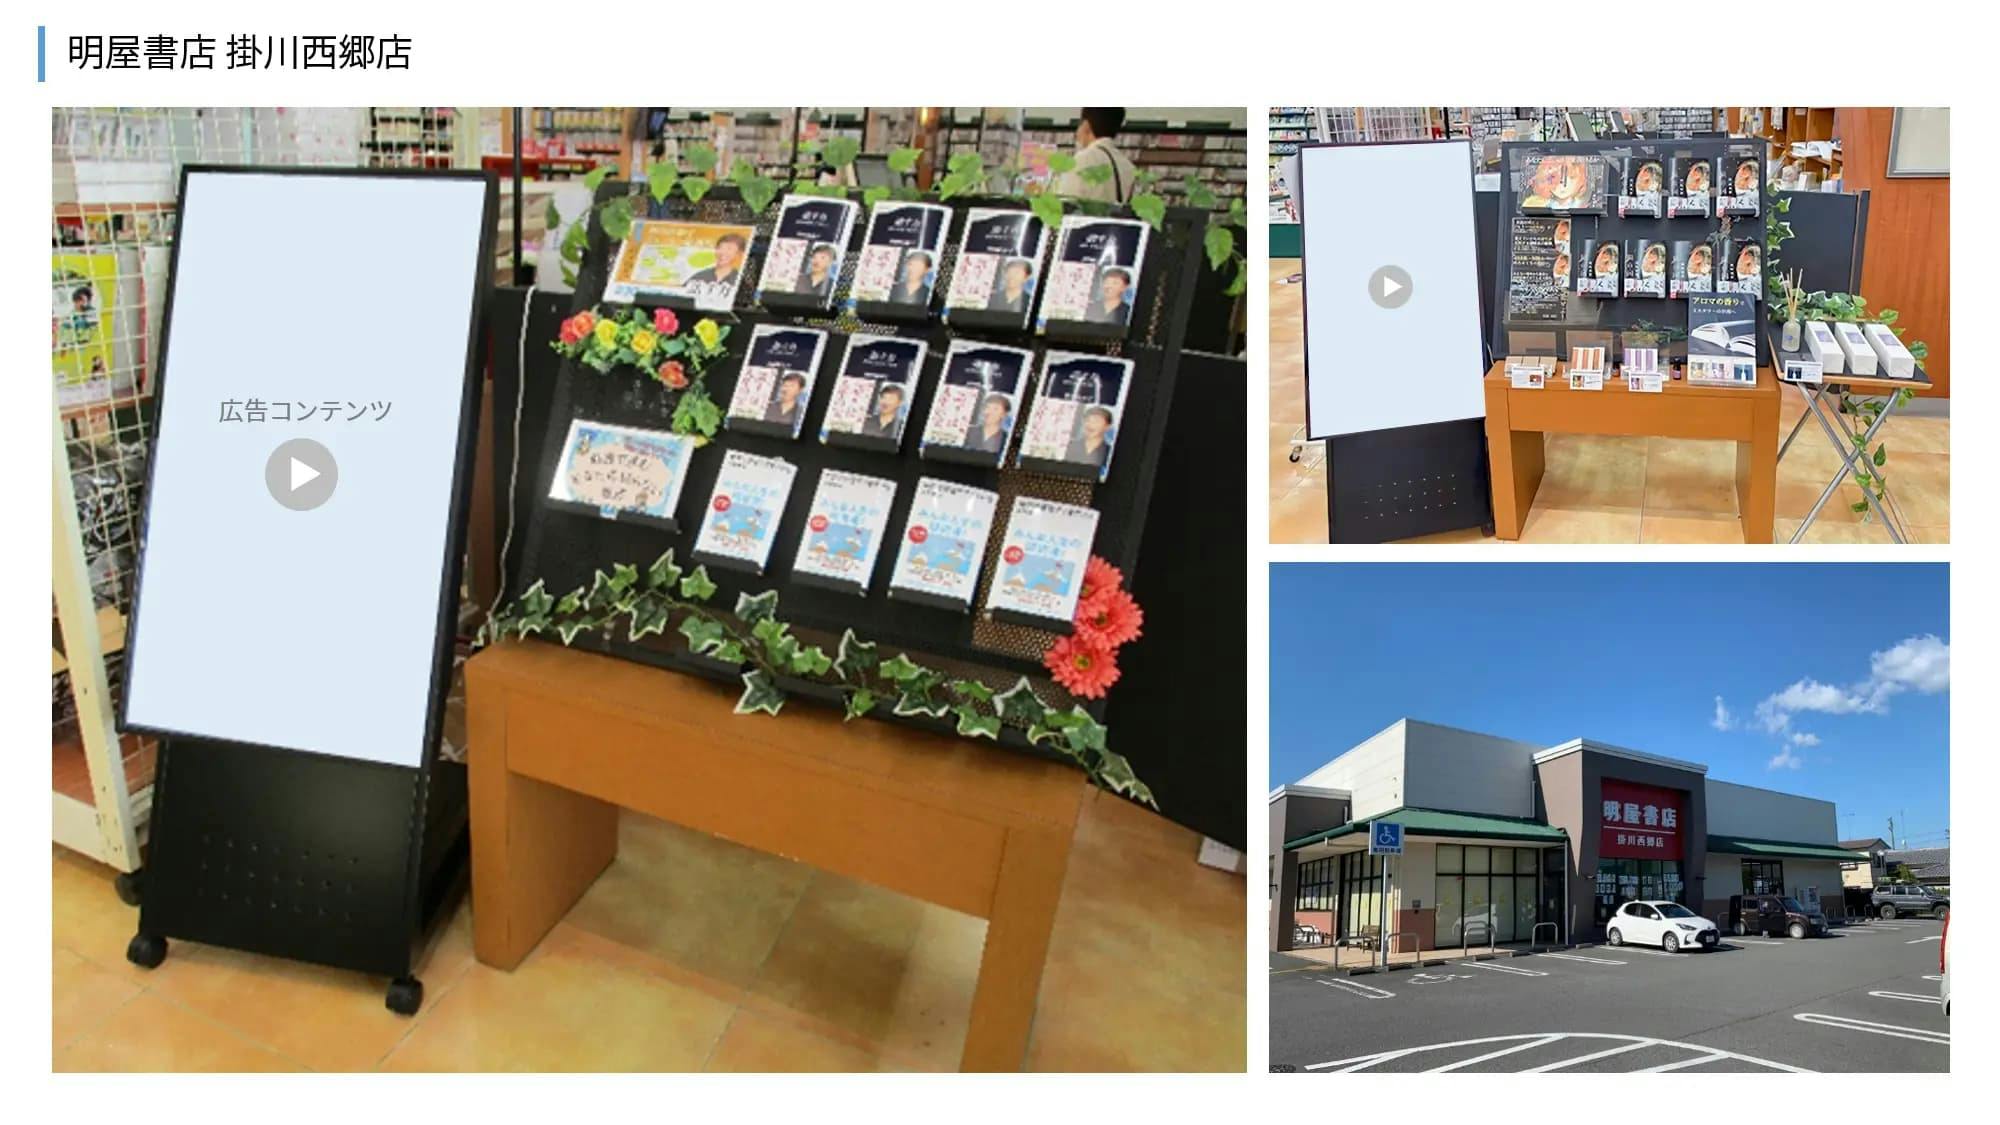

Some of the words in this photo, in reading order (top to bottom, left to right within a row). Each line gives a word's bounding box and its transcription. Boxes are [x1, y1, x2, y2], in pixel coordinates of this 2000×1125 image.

[1603, 800, 1677, 828] 明屋書店
[1617, 833, 1664, 848] 掛川西郷店
